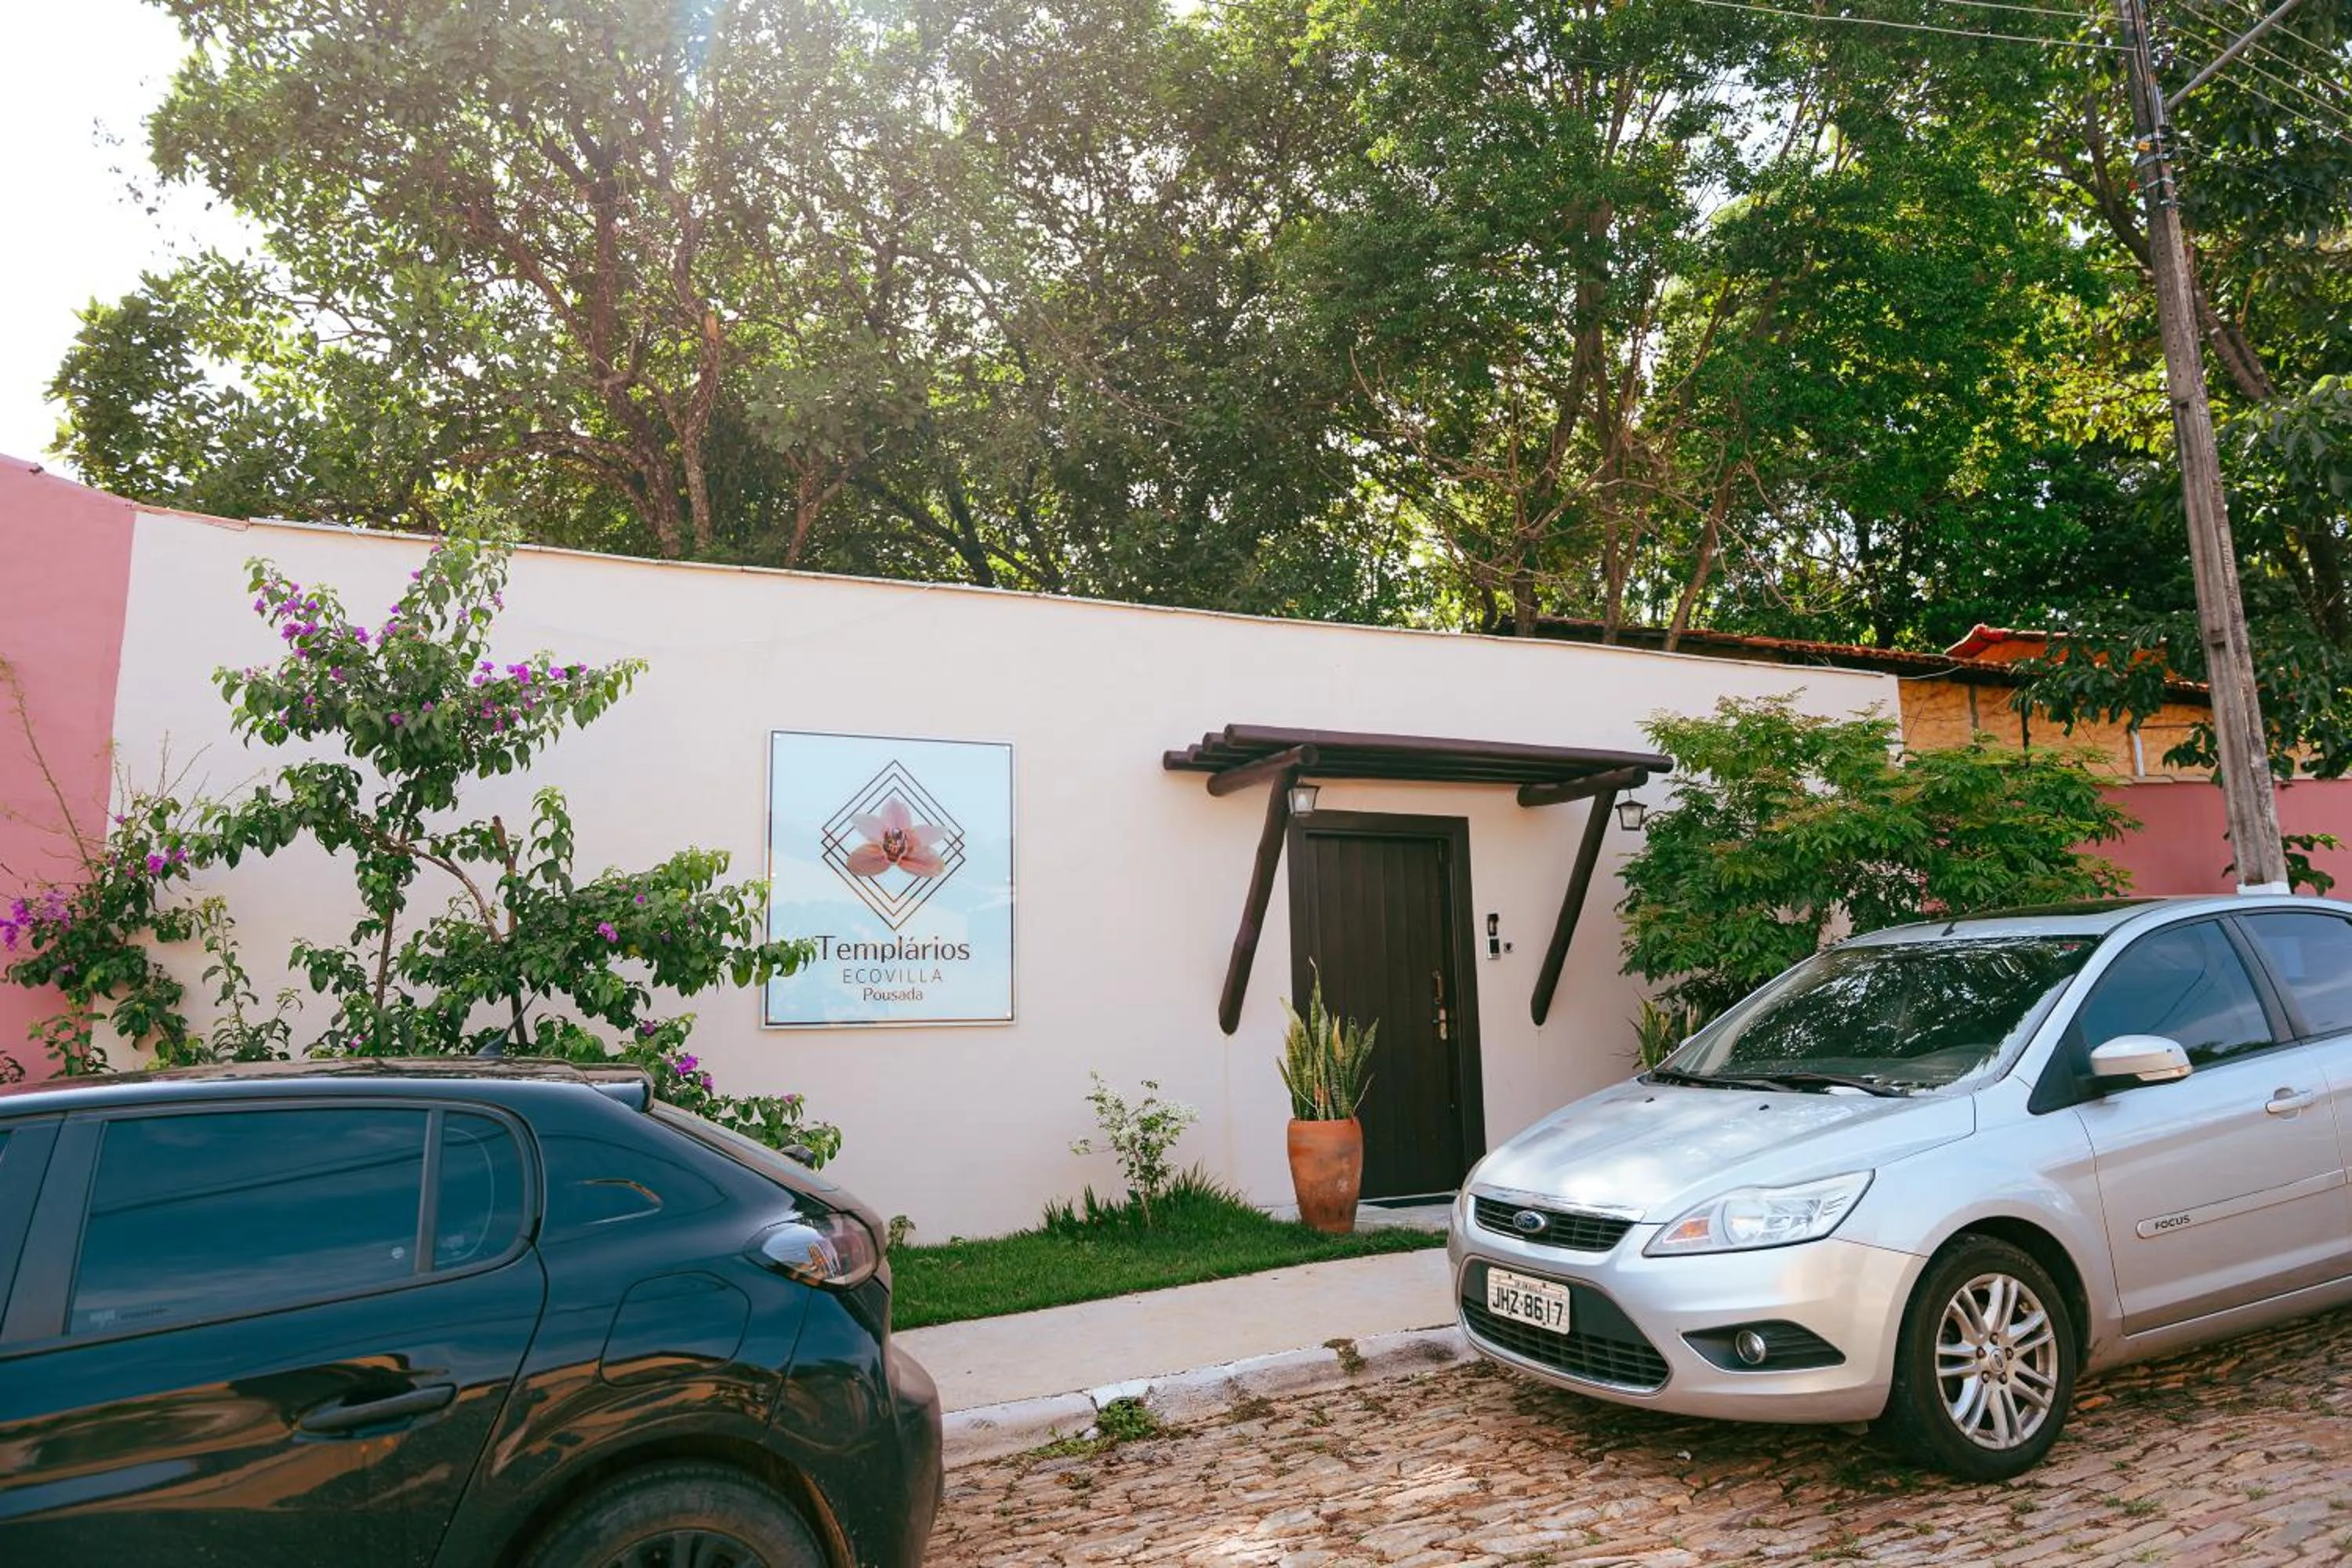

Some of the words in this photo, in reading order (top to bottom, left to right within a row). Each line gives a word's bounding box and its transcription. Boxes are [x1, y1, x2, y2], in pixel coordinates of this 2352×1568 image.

[815, 935, 971, 964] Templários
[842, 968, 943, 984] ECOVILLA
[862, 987, 924, 1002] Pousada
[2155, 1214, 2190, 1230] FOCUS
